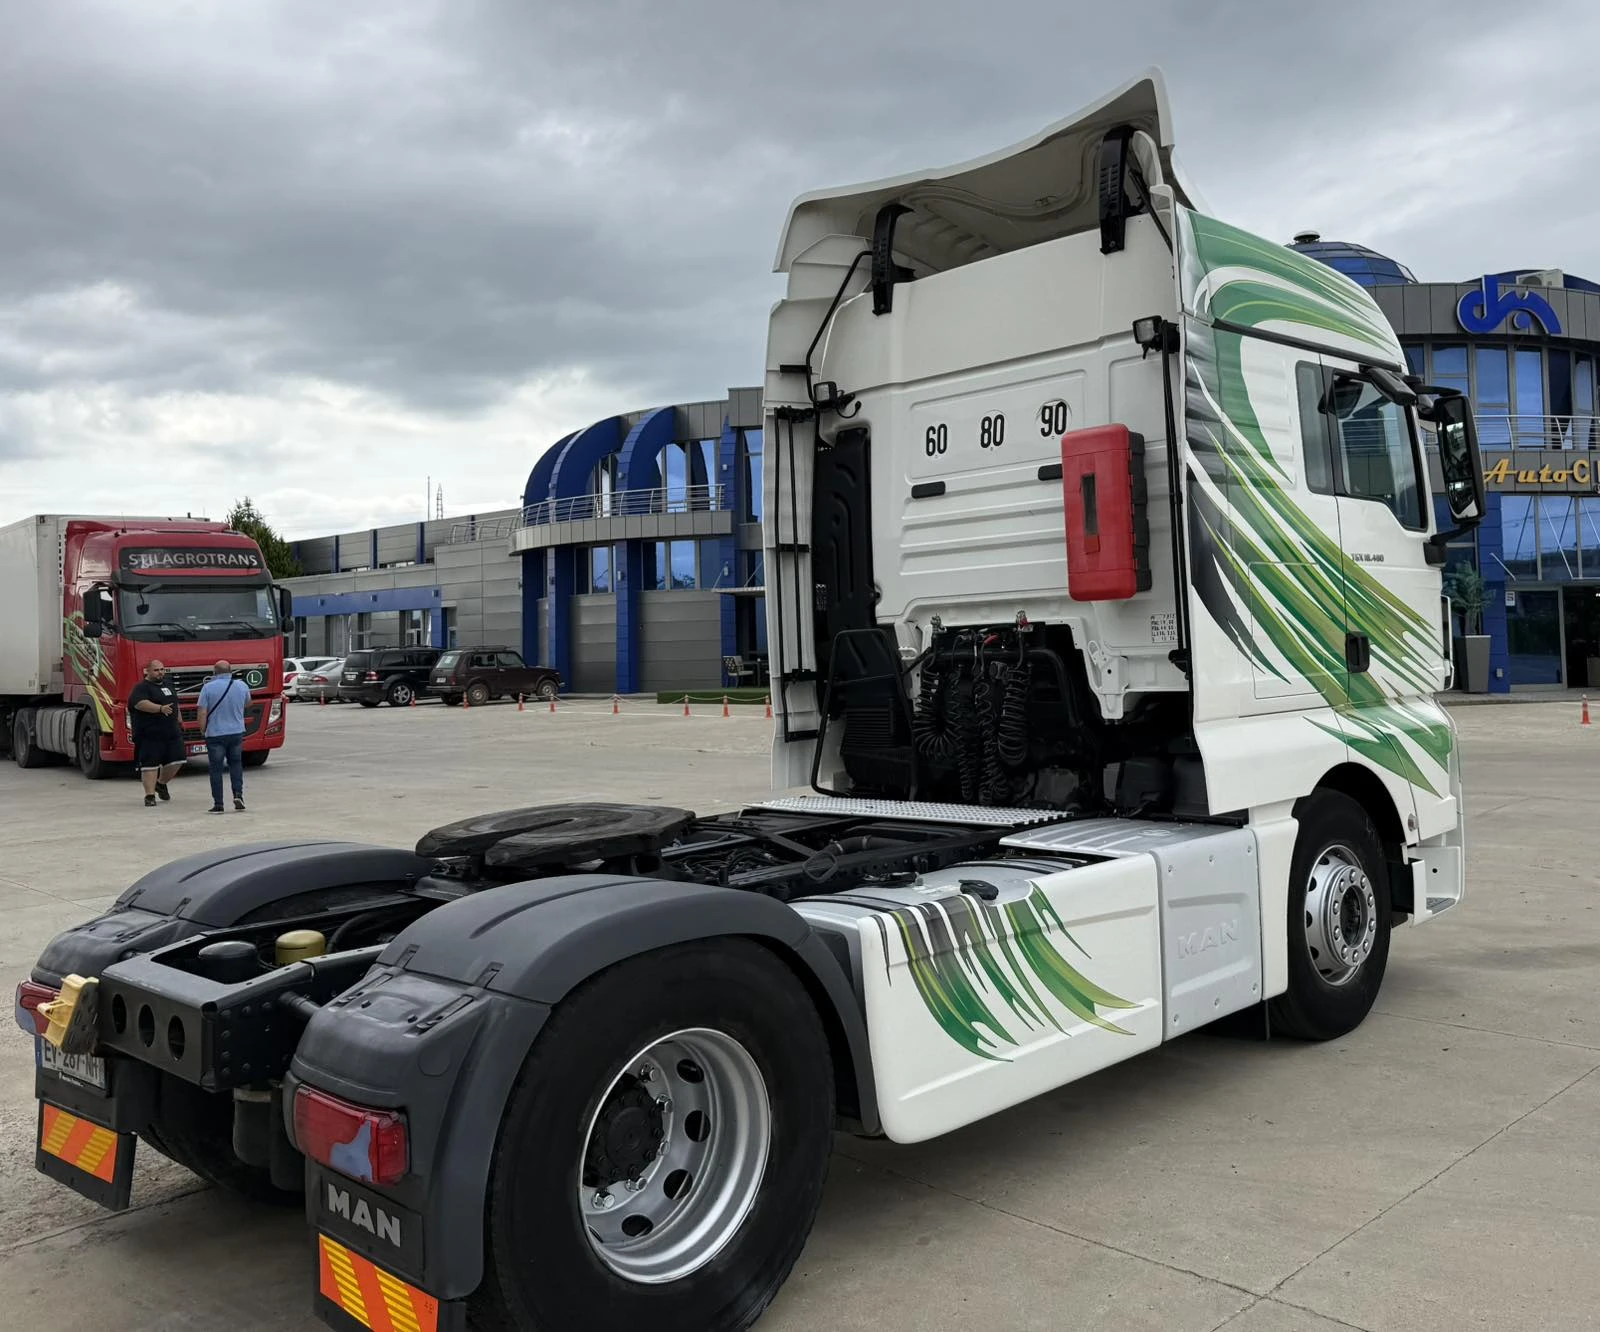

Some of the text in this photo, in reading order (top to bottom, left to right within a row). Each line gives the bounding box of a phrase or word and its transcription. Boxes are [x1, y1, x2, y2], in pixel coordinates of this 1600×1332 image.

[980, 414, 1005, 448] 80
[1040, 401, 1067, 437] 90
[926, 423, 948, 457] 60
[1483, 458, 1600, 486] AutoC
[128, 552, 258, 567] STILAGROTRANS
[1177, 920, 1240, 960] MAN
[328, 1183, 401, 1248] MAN
